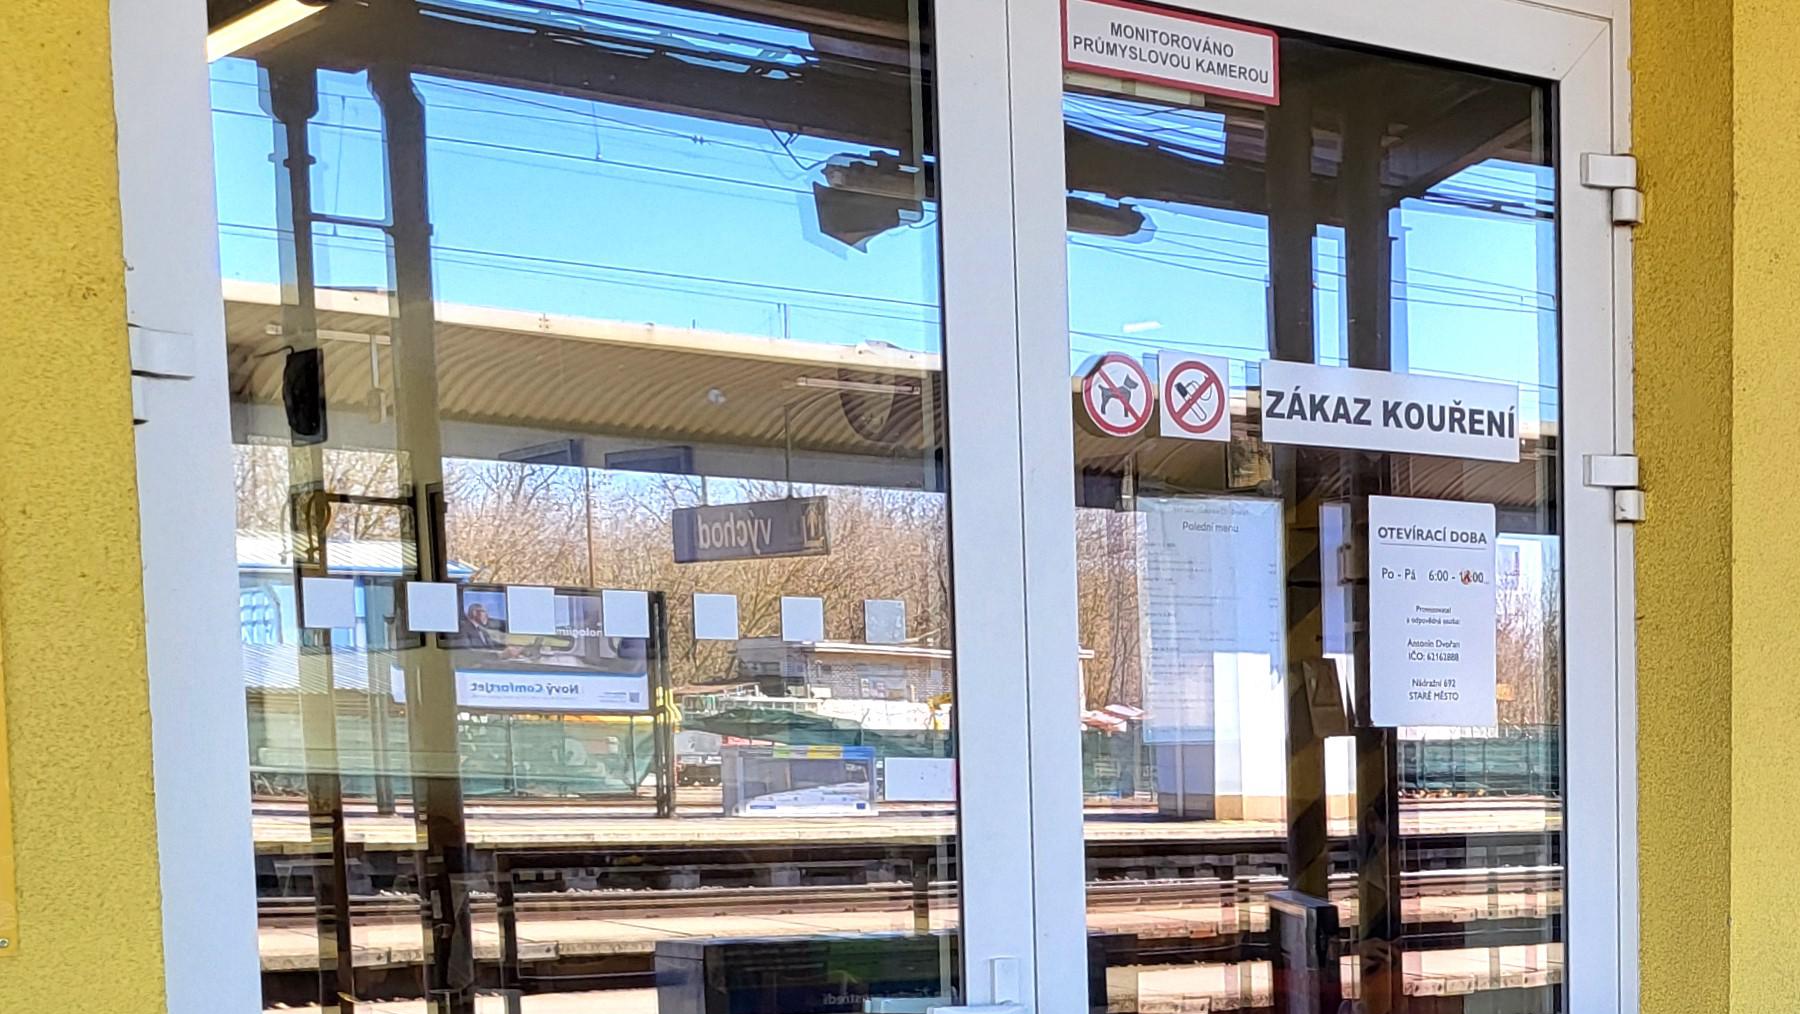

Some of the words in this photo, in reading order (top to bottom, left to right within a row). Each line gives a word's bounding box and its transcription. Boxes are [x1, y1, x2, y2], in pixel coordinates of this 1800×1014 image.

[1110, 22, 1234, 58] MONITOROVÁNO
[1073, 35, 1191, 70] PRŮMYSLOVOU
[1195, 58, 1269, 84] KAMEROU
[1265, 385, 1372, 426] ZÁKAZ
[1383, 399, 1515, 439] KOUŘENÍ
[1377, 524, 1447, 542] OTEVÍRACÍ
[1450, 530, 1488, 545] DOBA
[1381, 567, 1394, 579] Po
[1404, 568, 1416, 580] Pá
[1428, 569, 1449, 581] 6:00
